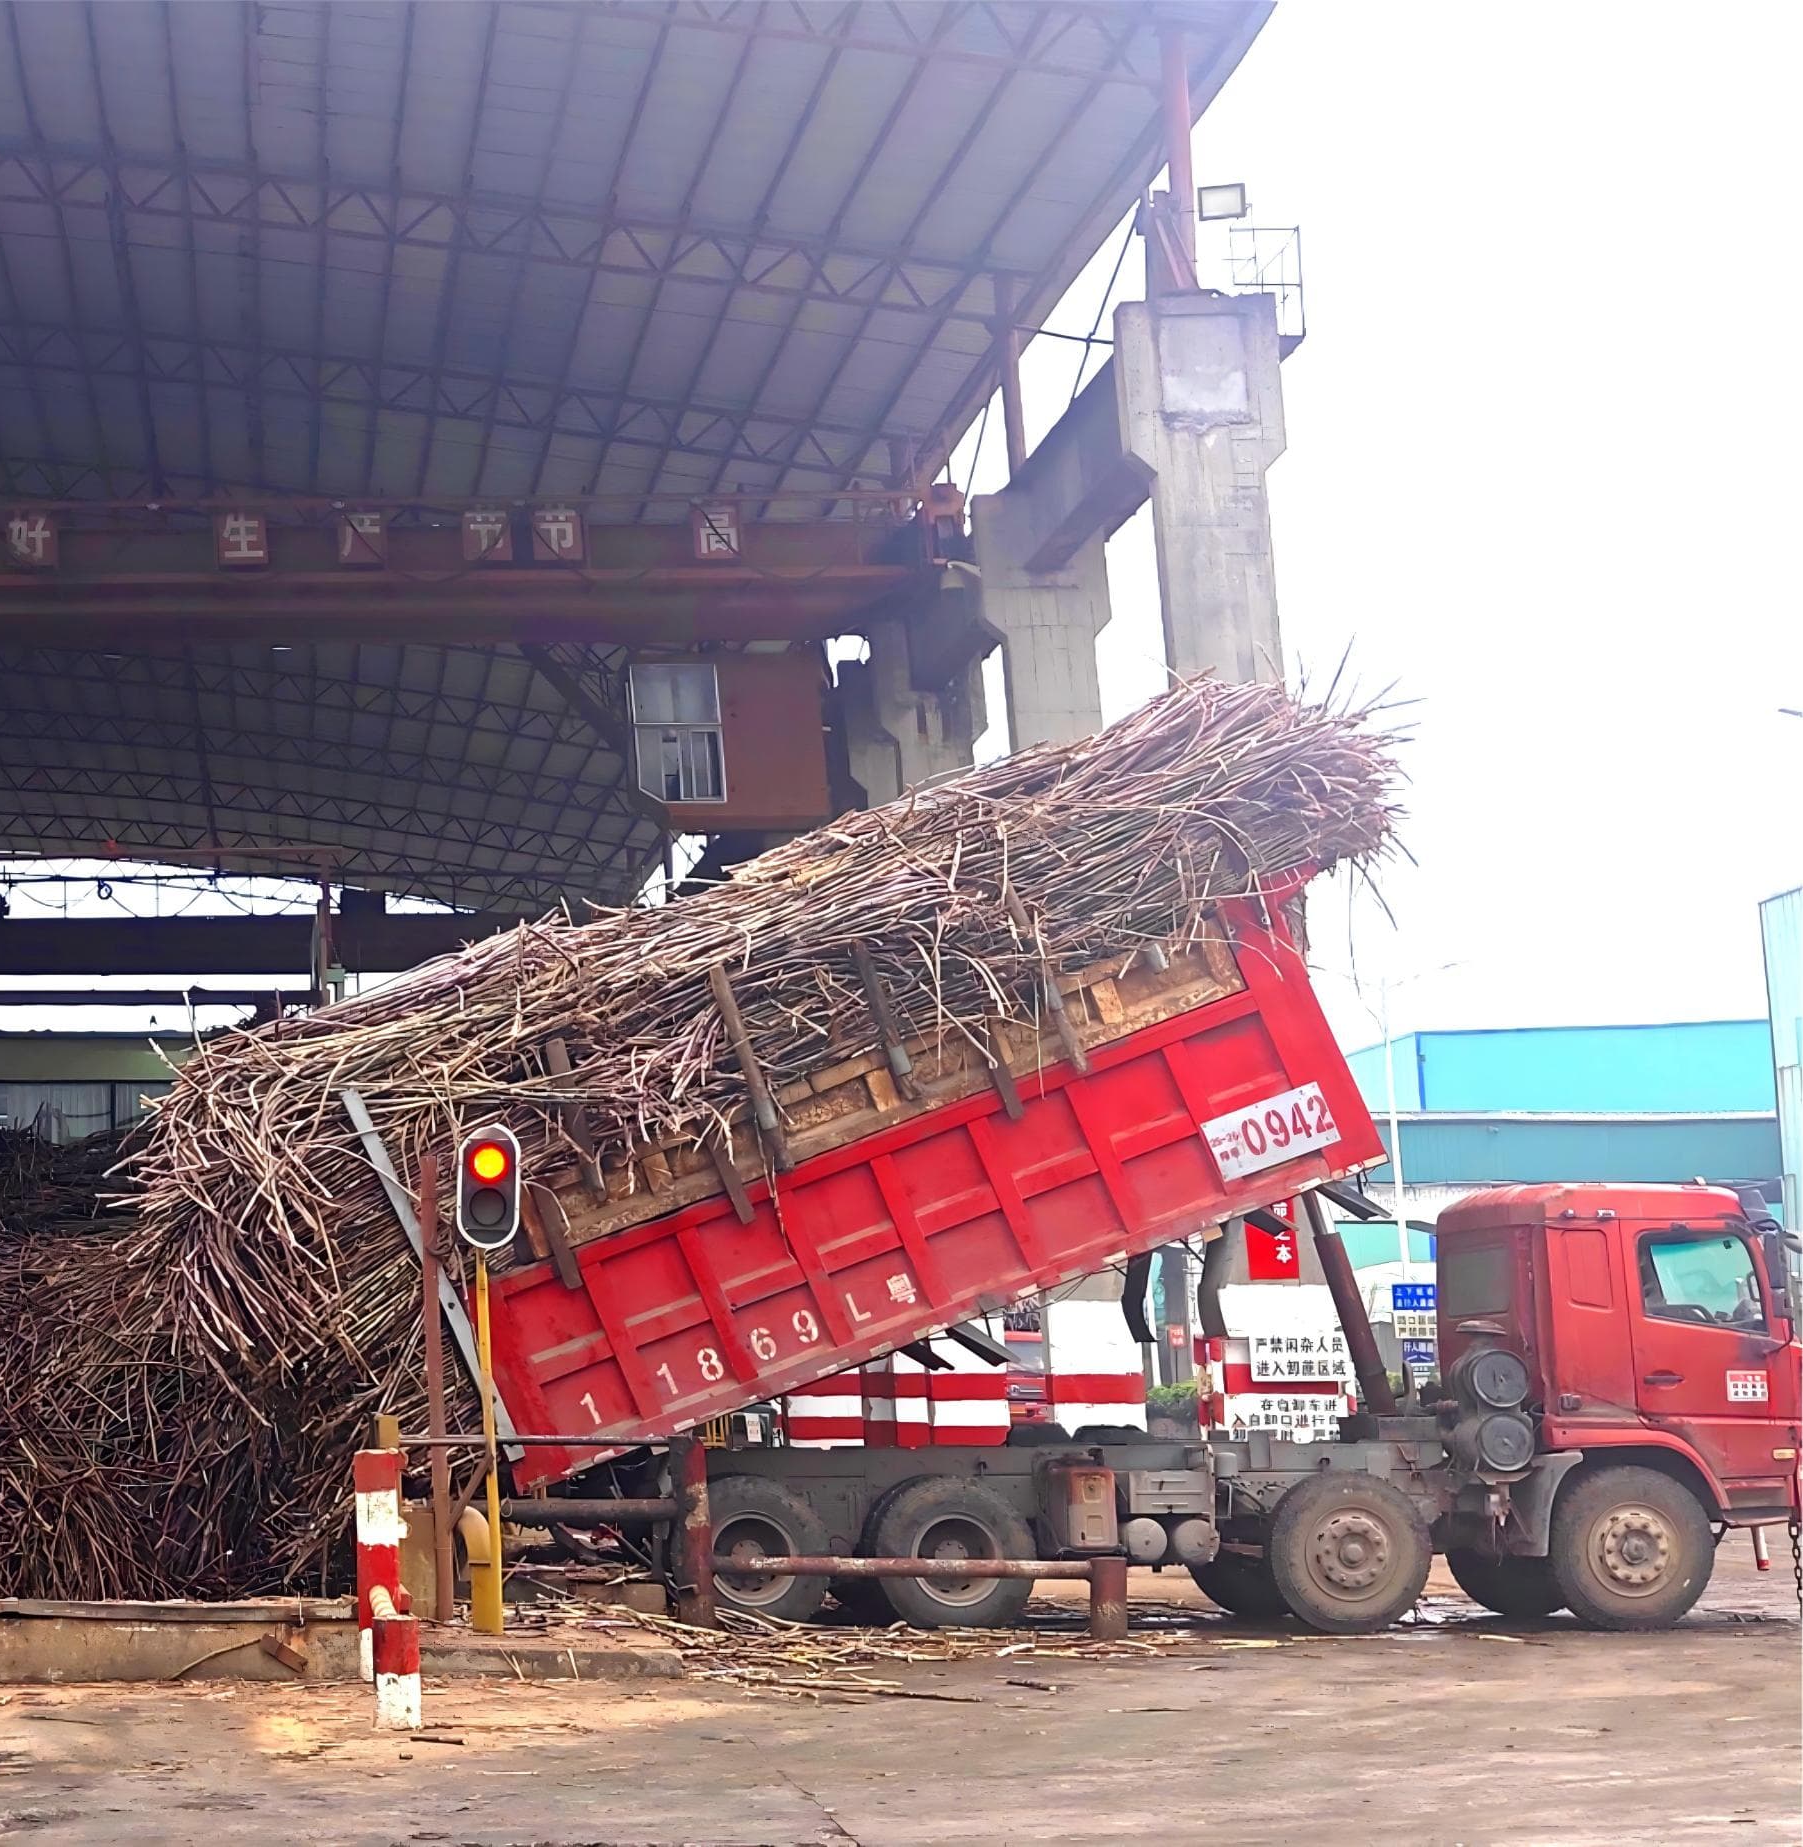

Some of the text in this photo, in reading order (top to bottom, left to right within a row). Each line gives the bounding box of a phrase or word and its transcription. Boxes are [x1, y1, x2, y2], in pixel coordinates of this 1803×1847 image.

[1241, 1094, 1335, 1156] 0942
[1255, 1336, 1344, 1353] 严禁闲杂人员
[1256, 1360, 1347, 1377] 进入卸蔗区域
